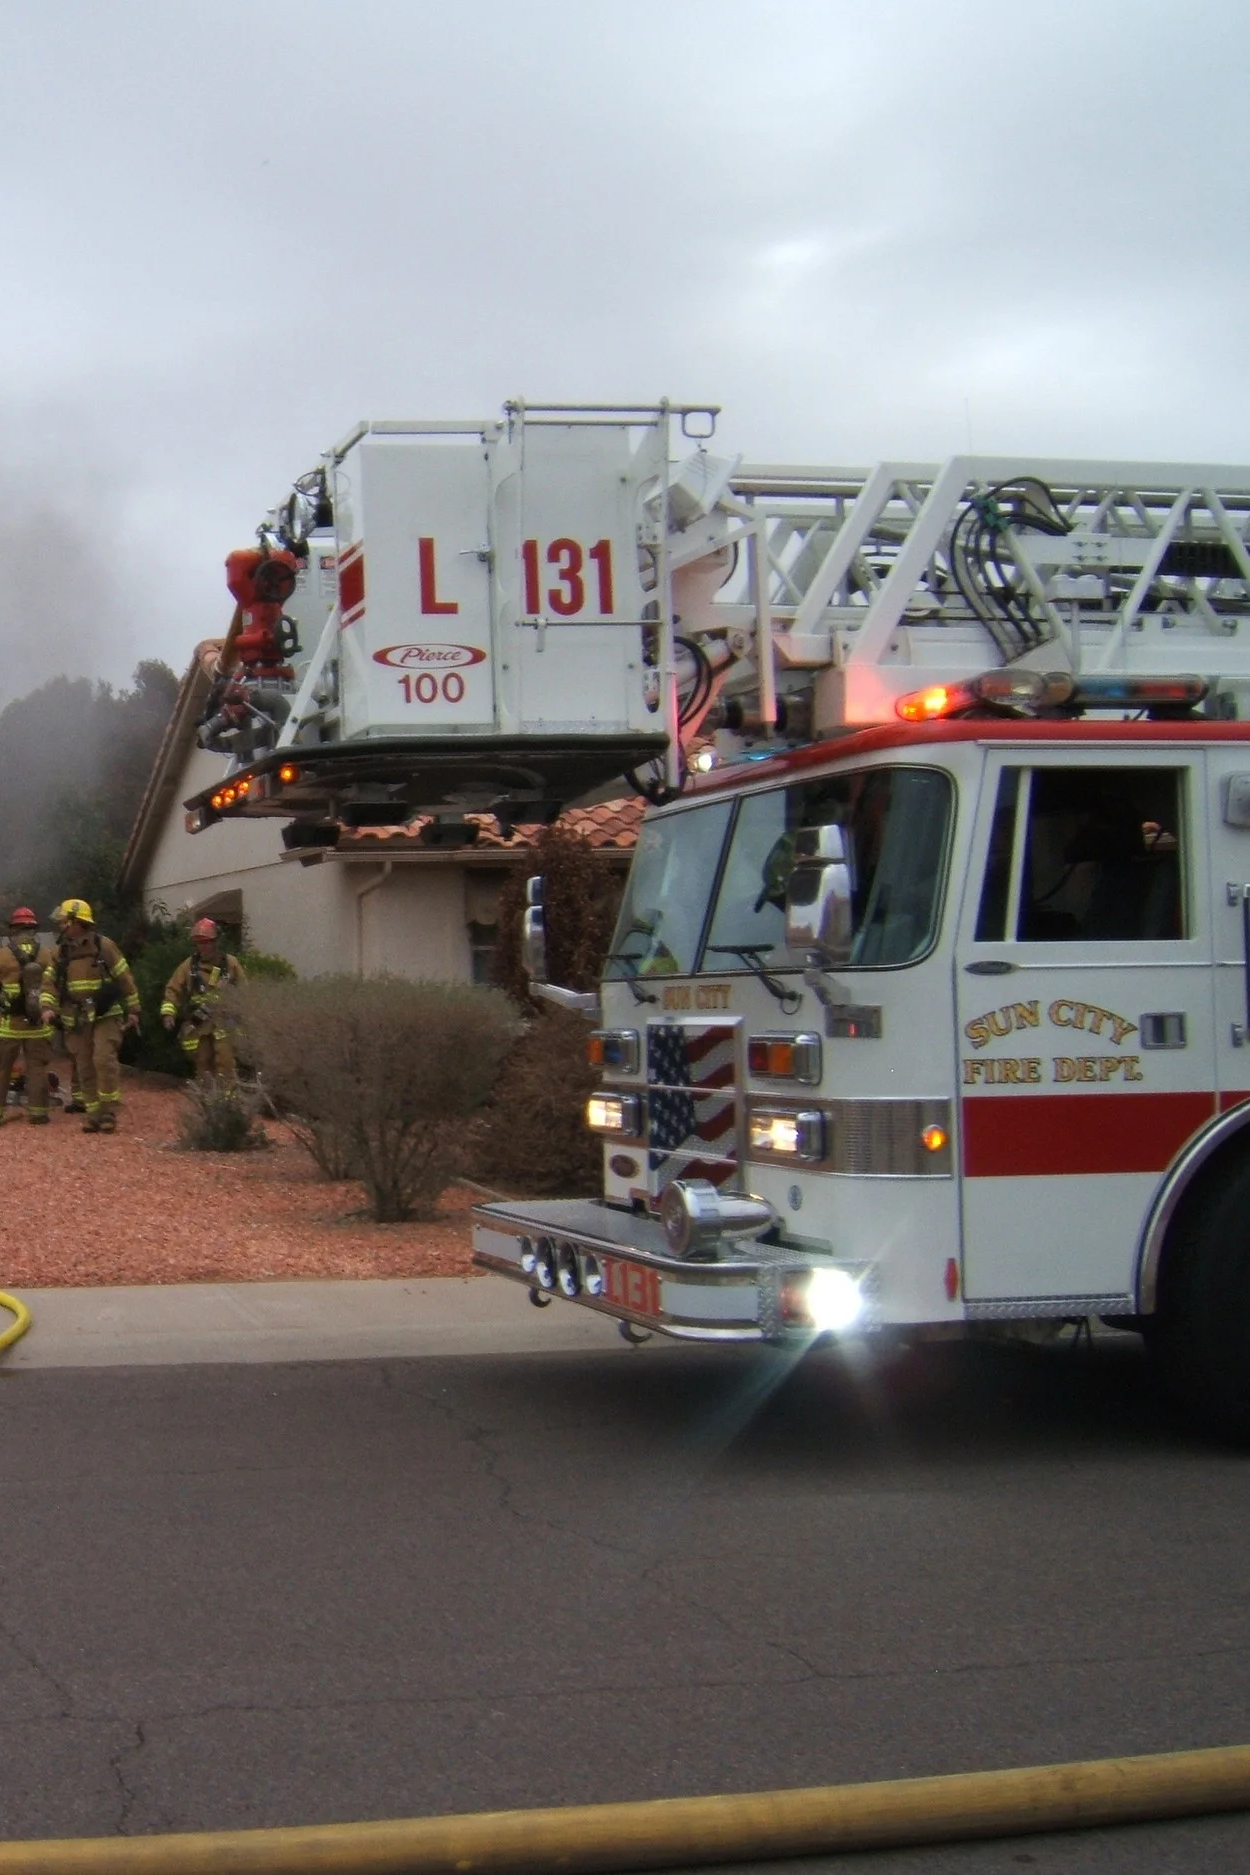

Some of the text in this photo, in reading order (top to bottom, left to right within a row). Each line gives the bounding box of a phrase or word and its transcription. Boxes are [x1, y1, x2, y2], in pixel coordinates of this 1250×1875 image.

[419, 537, 458, 614] L
[522, 538, 614, 616] 131
[399, 646, 462, 664] Pierce
[398, 672, 465, 704] 100
[964, 999, 1138, 1050] SUN CITY
[963, 1055, 1144, 1084] FIRE DEPT.
